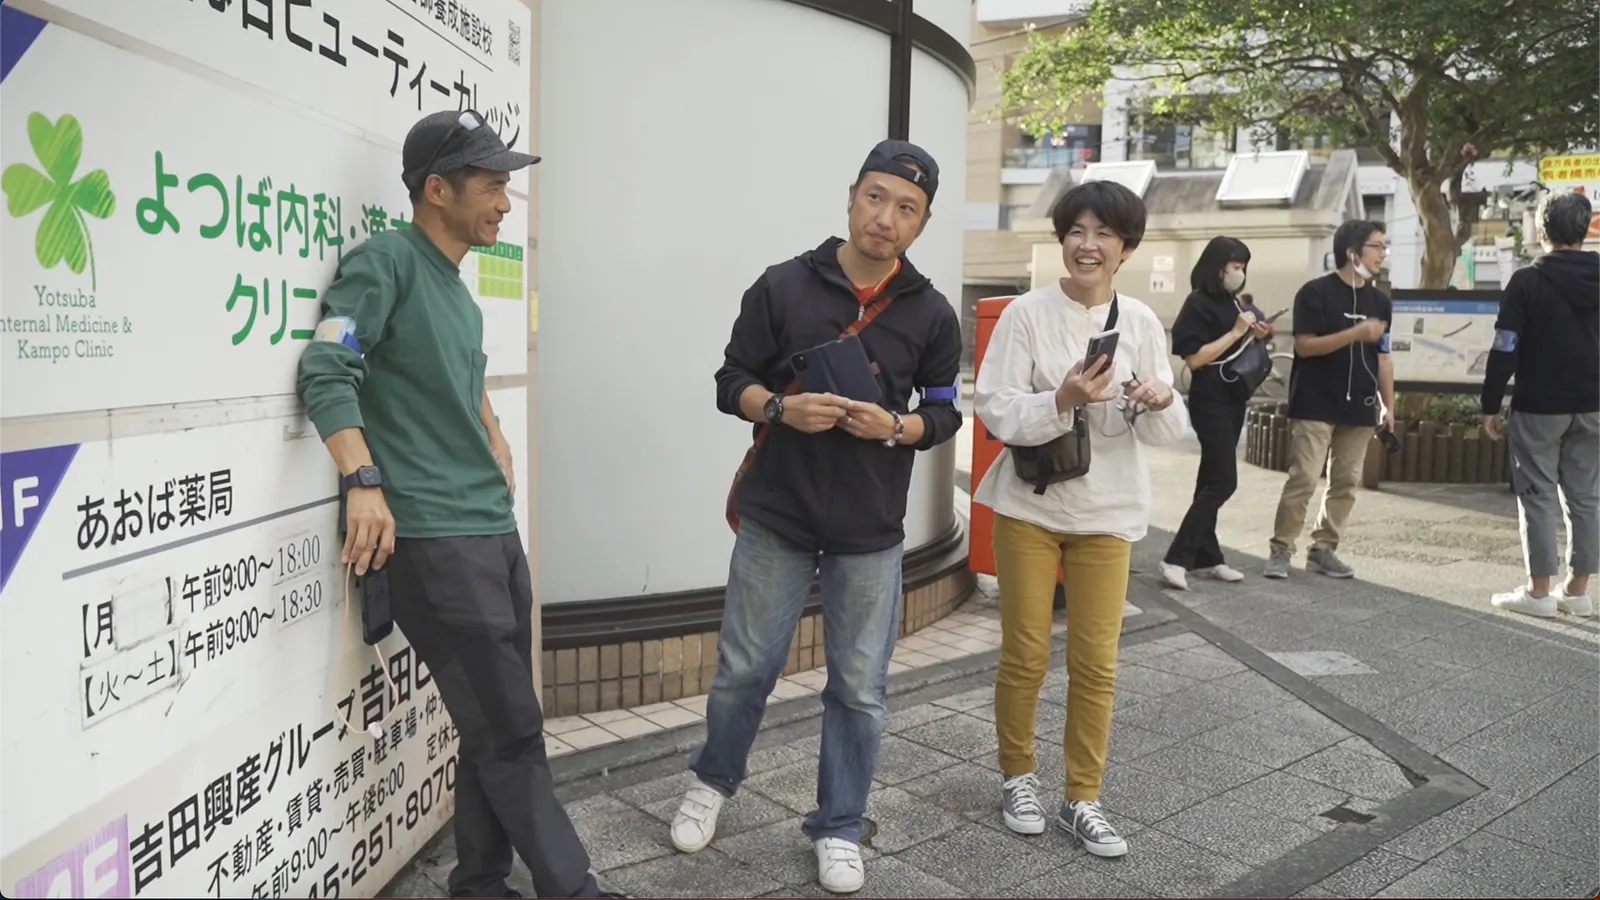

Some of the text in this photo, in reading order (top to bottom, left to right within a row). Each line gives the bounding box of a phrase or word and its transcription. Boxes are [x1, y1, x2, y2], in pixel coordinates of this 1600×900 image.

[411, 0, 493, 57] 養成施設校
[34, 284, 96, 308] Yotsuba
[56, 314, 118, 333] Medicine
[122, 316, 132, 333] &
[226, 273, 318, 345] クリニ
[17, 339, 114, 364] Kampo Clinic
[0, 476, 39, 531] F
[77, 468, 233, 550] あおば薬局
[207, 692, 444, 898] 不動産・賃貸・売買・駐車場・仲
